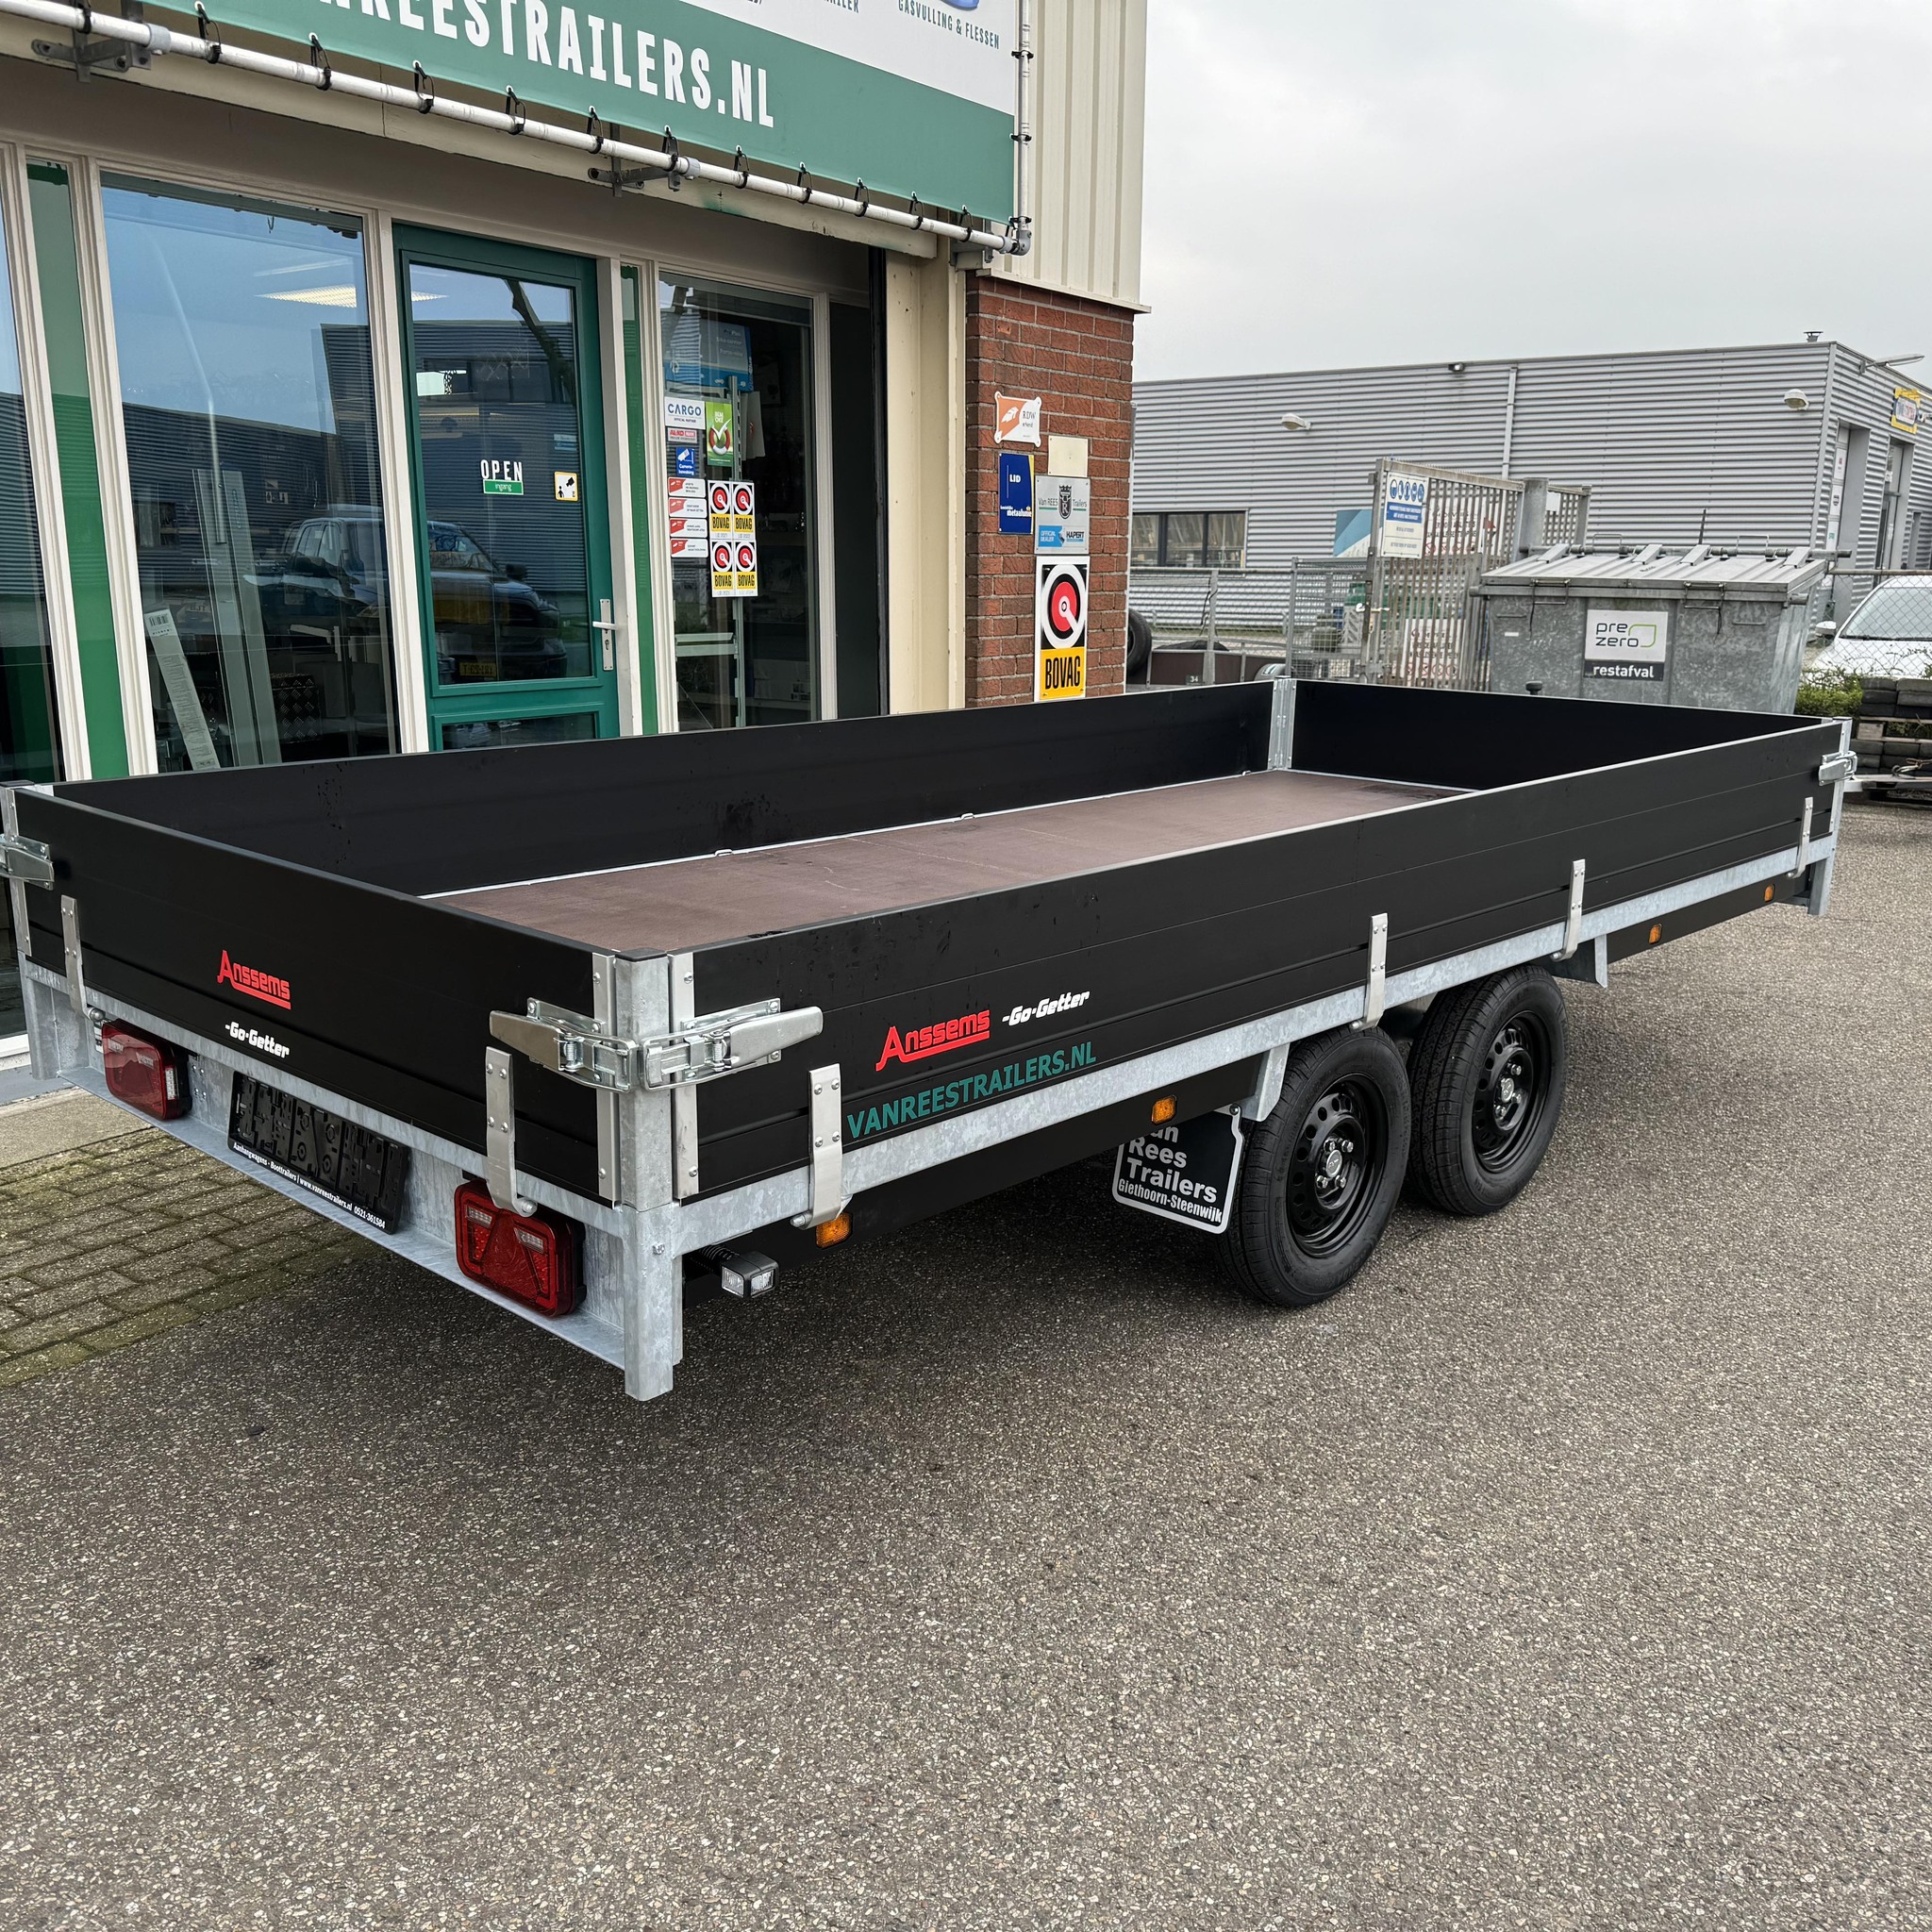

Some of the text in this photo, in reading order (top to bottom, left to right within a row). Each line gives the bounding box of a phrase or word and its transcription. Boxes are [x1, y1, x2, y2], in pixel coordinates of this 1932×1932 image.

[956, 18, 962, 35] &
[965, 22, 1000, 50] FLESSEN
[667, 404, 702, 416] CARGO
[1023, 410, 1037, 419] RDW
[480, 459, 523, 482] OPEN
[1009, 474, 1021, 483] LID
[1038, 497, 1047, 506] Van
[1073, 498, 1088, 508] Trailers
[712, 517, 730, 529] BOVAG
[735, 517, 753, 530] BOVAG
[714, 575, 732, 588] BOVAG
[737, 575, 755, 587] BOVAG
[1595, 623, 1628, 635] pre
[1595, 637, 1639, 648] zero
[1045, 656, 1081, 691] BOVAG
[1592, 665, 1655, 678] restafval
[217, 949, 291, 1009] Anssems
[875, 1009, 990, 1072] Anssems
[847, 1041, 1096, 1139] VANREESTRAILERS.NL
[1128, 1136, 1188, 1168] Rees
[233, 1141, 268, 1166] Aanhangwagens
[270, 1160, 297, 1181] Boottrailers
[300, 1178, 353, 1211] www.vanreestrailers.nl
[1126, 1157, 1218, 1204] Trailers
[1118, 1178, 1223, 1224] Giethoorn-Steenwijk
